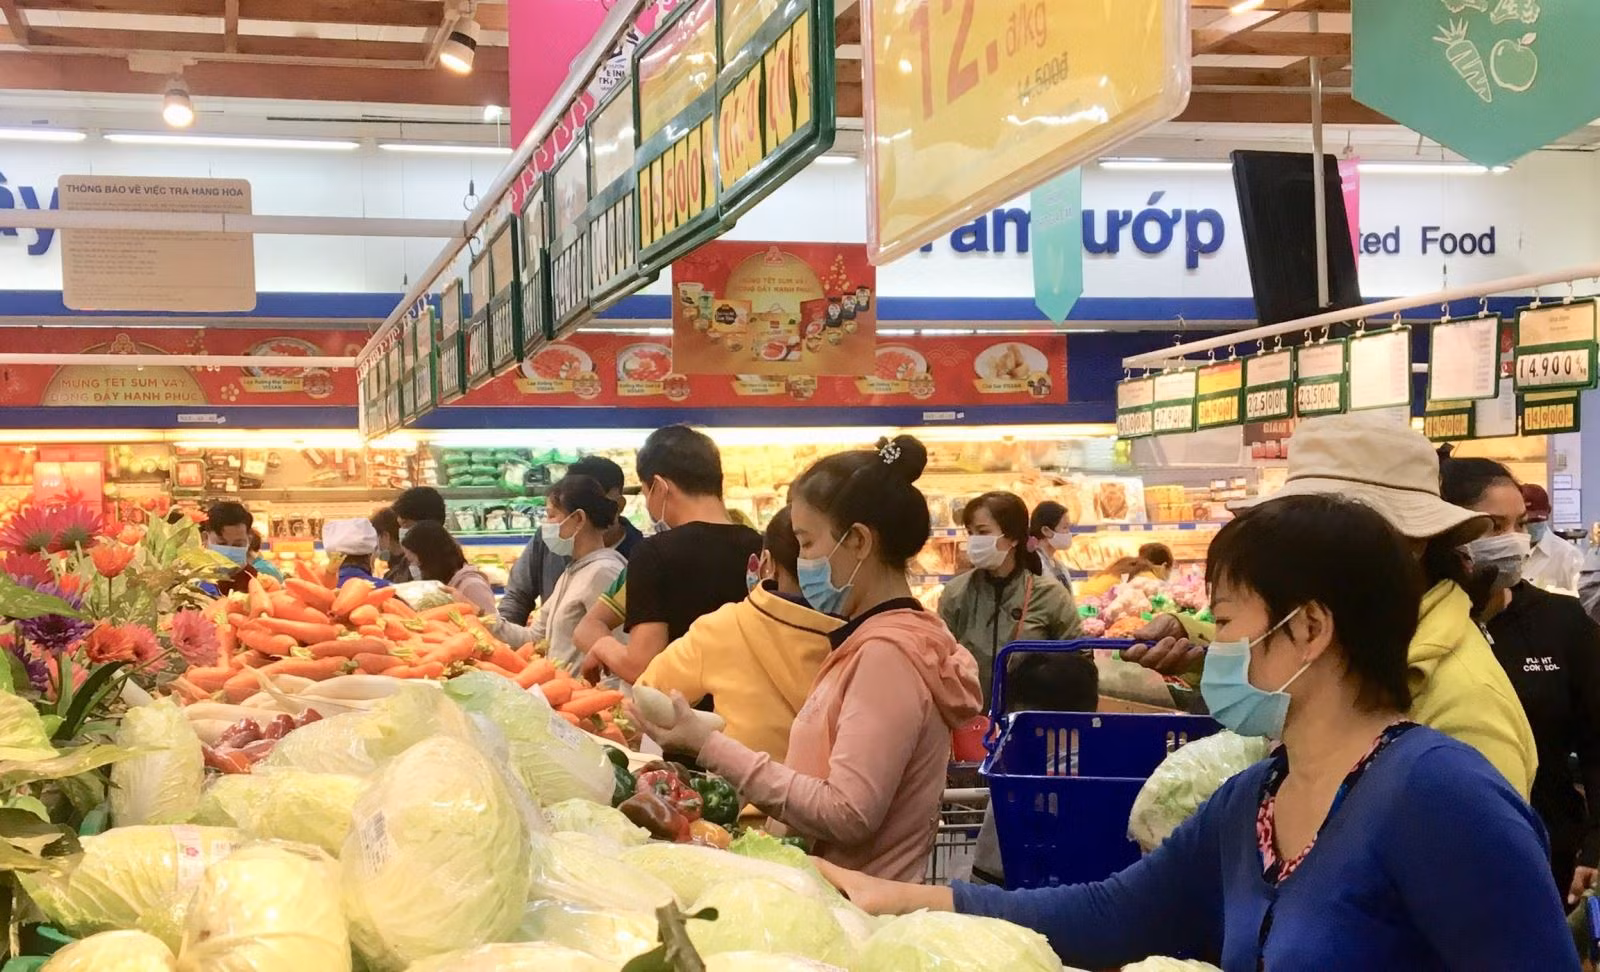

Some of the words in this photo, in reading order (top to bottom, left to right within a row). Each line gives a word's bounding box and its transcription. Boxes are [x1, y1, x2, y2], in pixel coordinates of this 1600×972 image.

[1081, 190, 1225, 269] ướp
[1421, 225, 1496, 255] Food
[1519, 354, 1572, 379] 14.900
[130, 377, 158, 388] SUM
[1525, 656, 1553, 665] FLIHT
